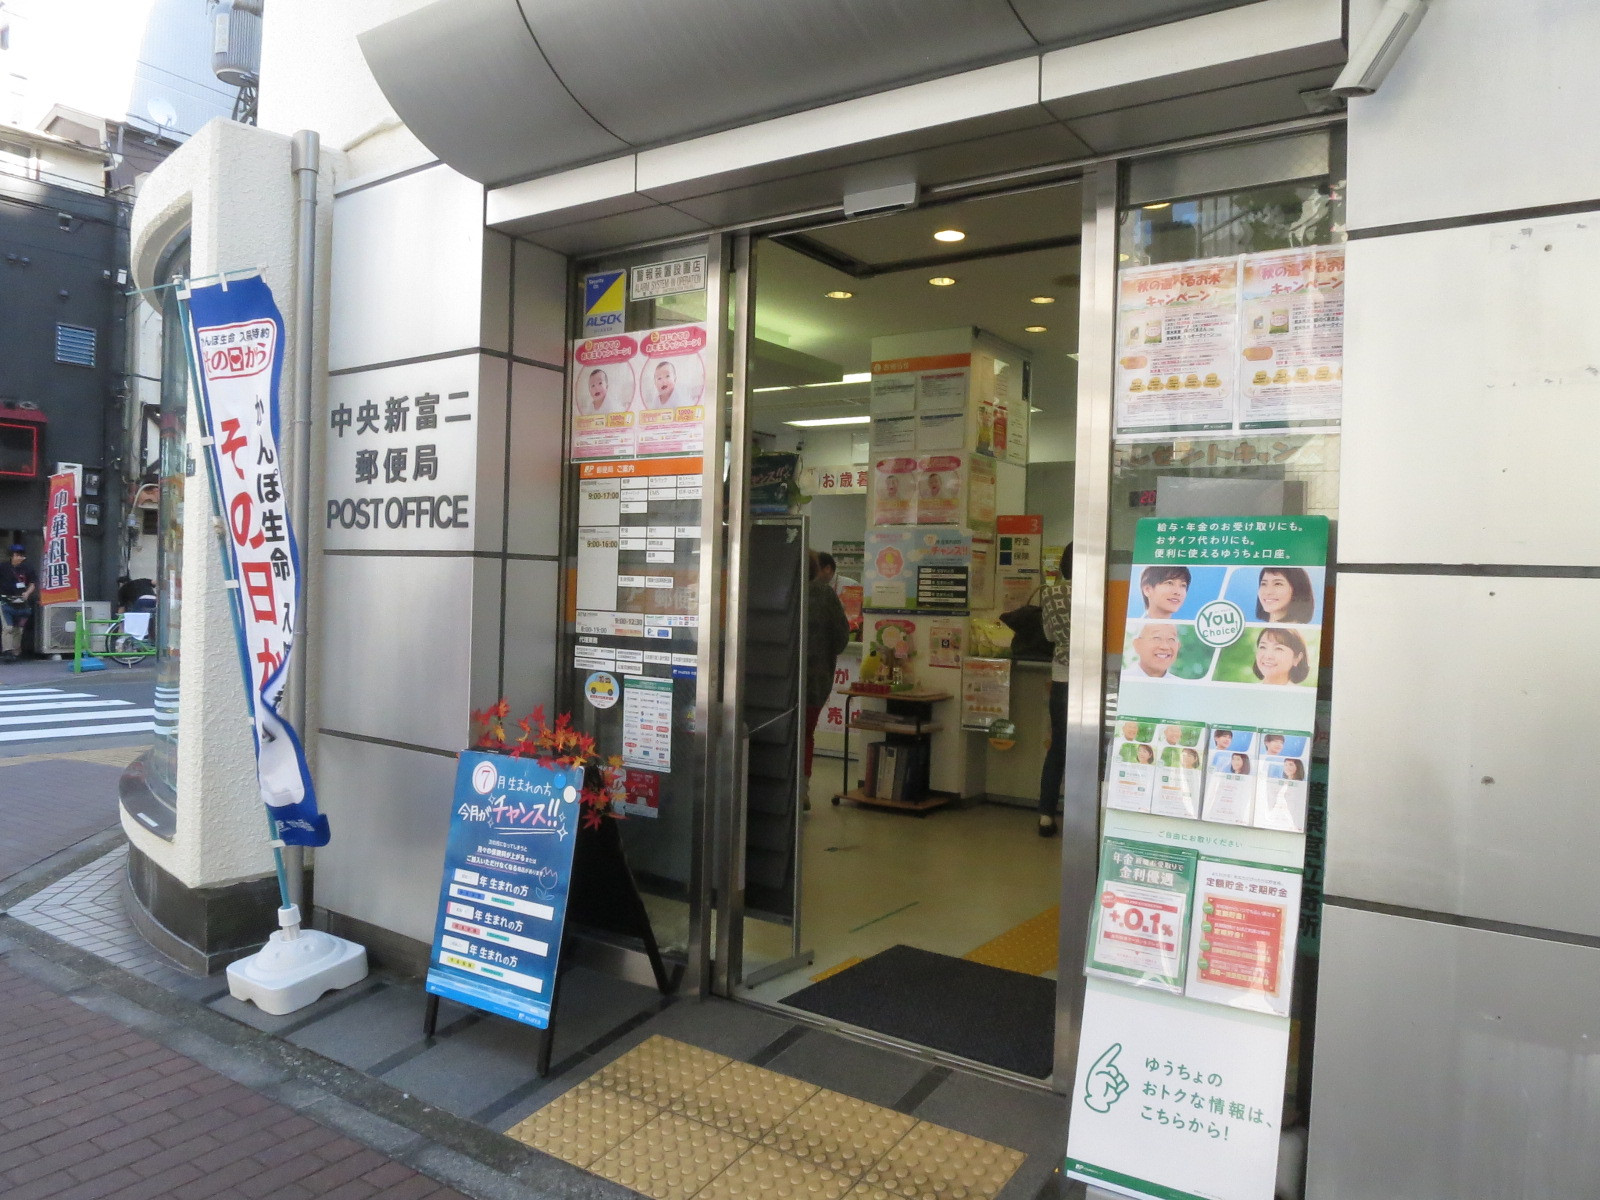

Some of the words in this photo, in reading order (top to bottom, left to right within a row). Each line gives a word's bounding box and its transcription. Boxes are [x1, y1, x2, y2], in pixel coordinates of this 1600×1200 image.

[651, 278, 670, 291] SYSTEM
[677, 273, 701, 287] OPERATION
[1146, 291, 1211, 307] キャンペーン
[586, 313, 622, 328] ALSOK
[331, 391, 471, 438] 中央新富二
[355, 444, 438, 484] 郵便局
[254, 394, 289, 581] かんぽ生命
[327, 497, 384, 529] POST
[384, 495, 469, 529] OFFICE
[1157, 521, 1303, 532] 給与・年金のお受け取りにも。
[46, 489, 71, 590] 中華料理
[1014, 537, 1030, 546] 貯金
[1155, 535, 1255, 545] おサイフ代わりにも。
[1154, 548, 1291, 559] 便利に使えるゆうちょ口座。
[1201, 611, 1235, 628] You
[1158, 830, 1242, 847] ご自由にお取りください
[480, 875, 529, 897] 年生まれの方
[1119, 865, 1174, 887] 金利優遇
[1206, 877, 1288, 898] 定額貯金・定期貯金
[474, 909, 524, 932] 年生まれの方
[469, 944, 518, 968] 年生まれの方
[1145, 1057, 1222, 1087] ゆうちょの
[1142, 1080, 1272, 1128] おトクな情報は、
[1141, 1105, 1229, 1141] こちらから!
